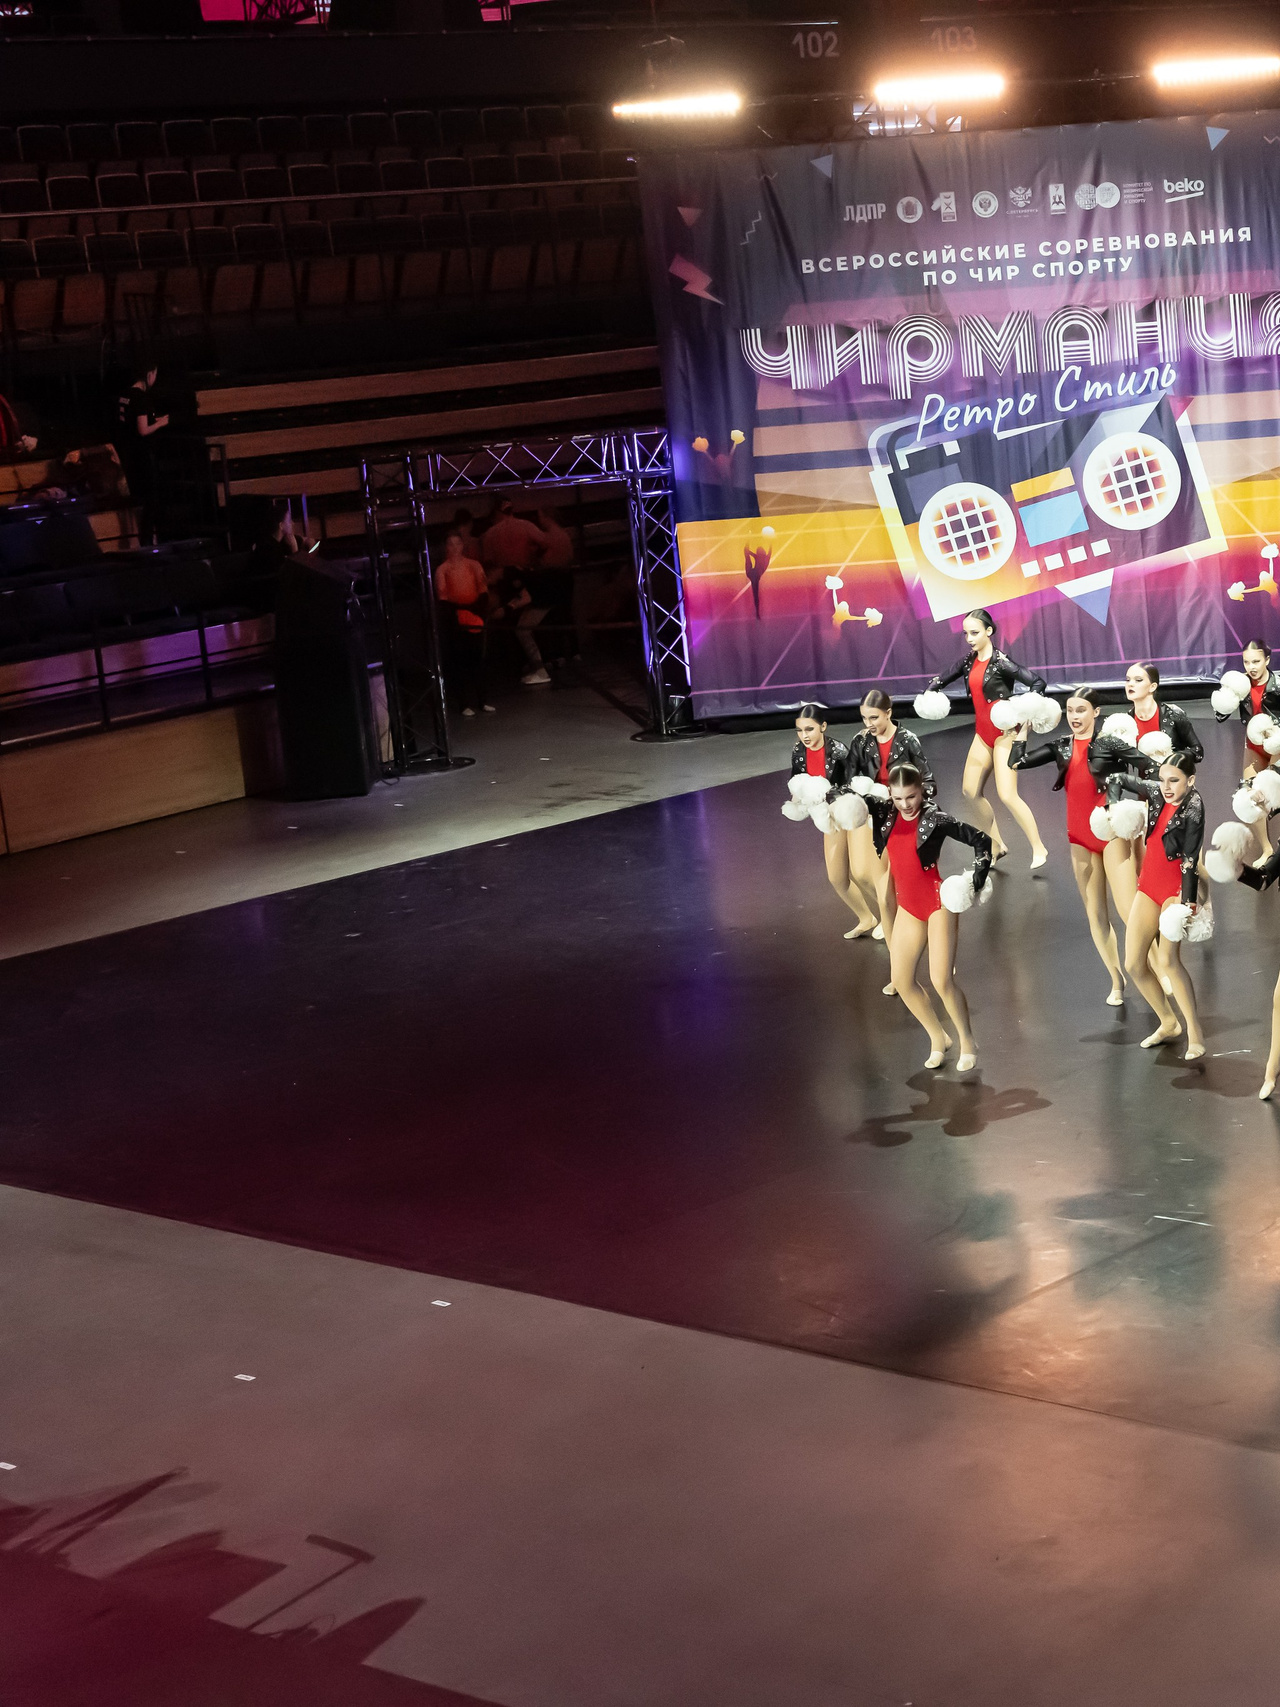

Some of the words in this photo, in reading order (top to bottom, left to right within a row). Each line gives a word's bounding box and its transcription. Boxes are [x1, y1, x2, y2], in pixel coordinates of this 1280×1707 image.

[792, 31, 840, 58] 102
[1163, 177, 1205, 194] beko
[843, 203, 886, 223] ЛДПР
[801, 243, 1027, 274] ВСЕРОССИЙСКИЕ
[1038, 226, 1252, 258] СОРЕВНОВАНИЯ
[923, 270, 957, 287] ПО
[970, 264, 1021, 283] ЧИР
[1032, 256, 1134, 279] СПОРТУ
[917, 392, 1037, 442] Ретро
[1054, 363, 1178, 413] Стиль
